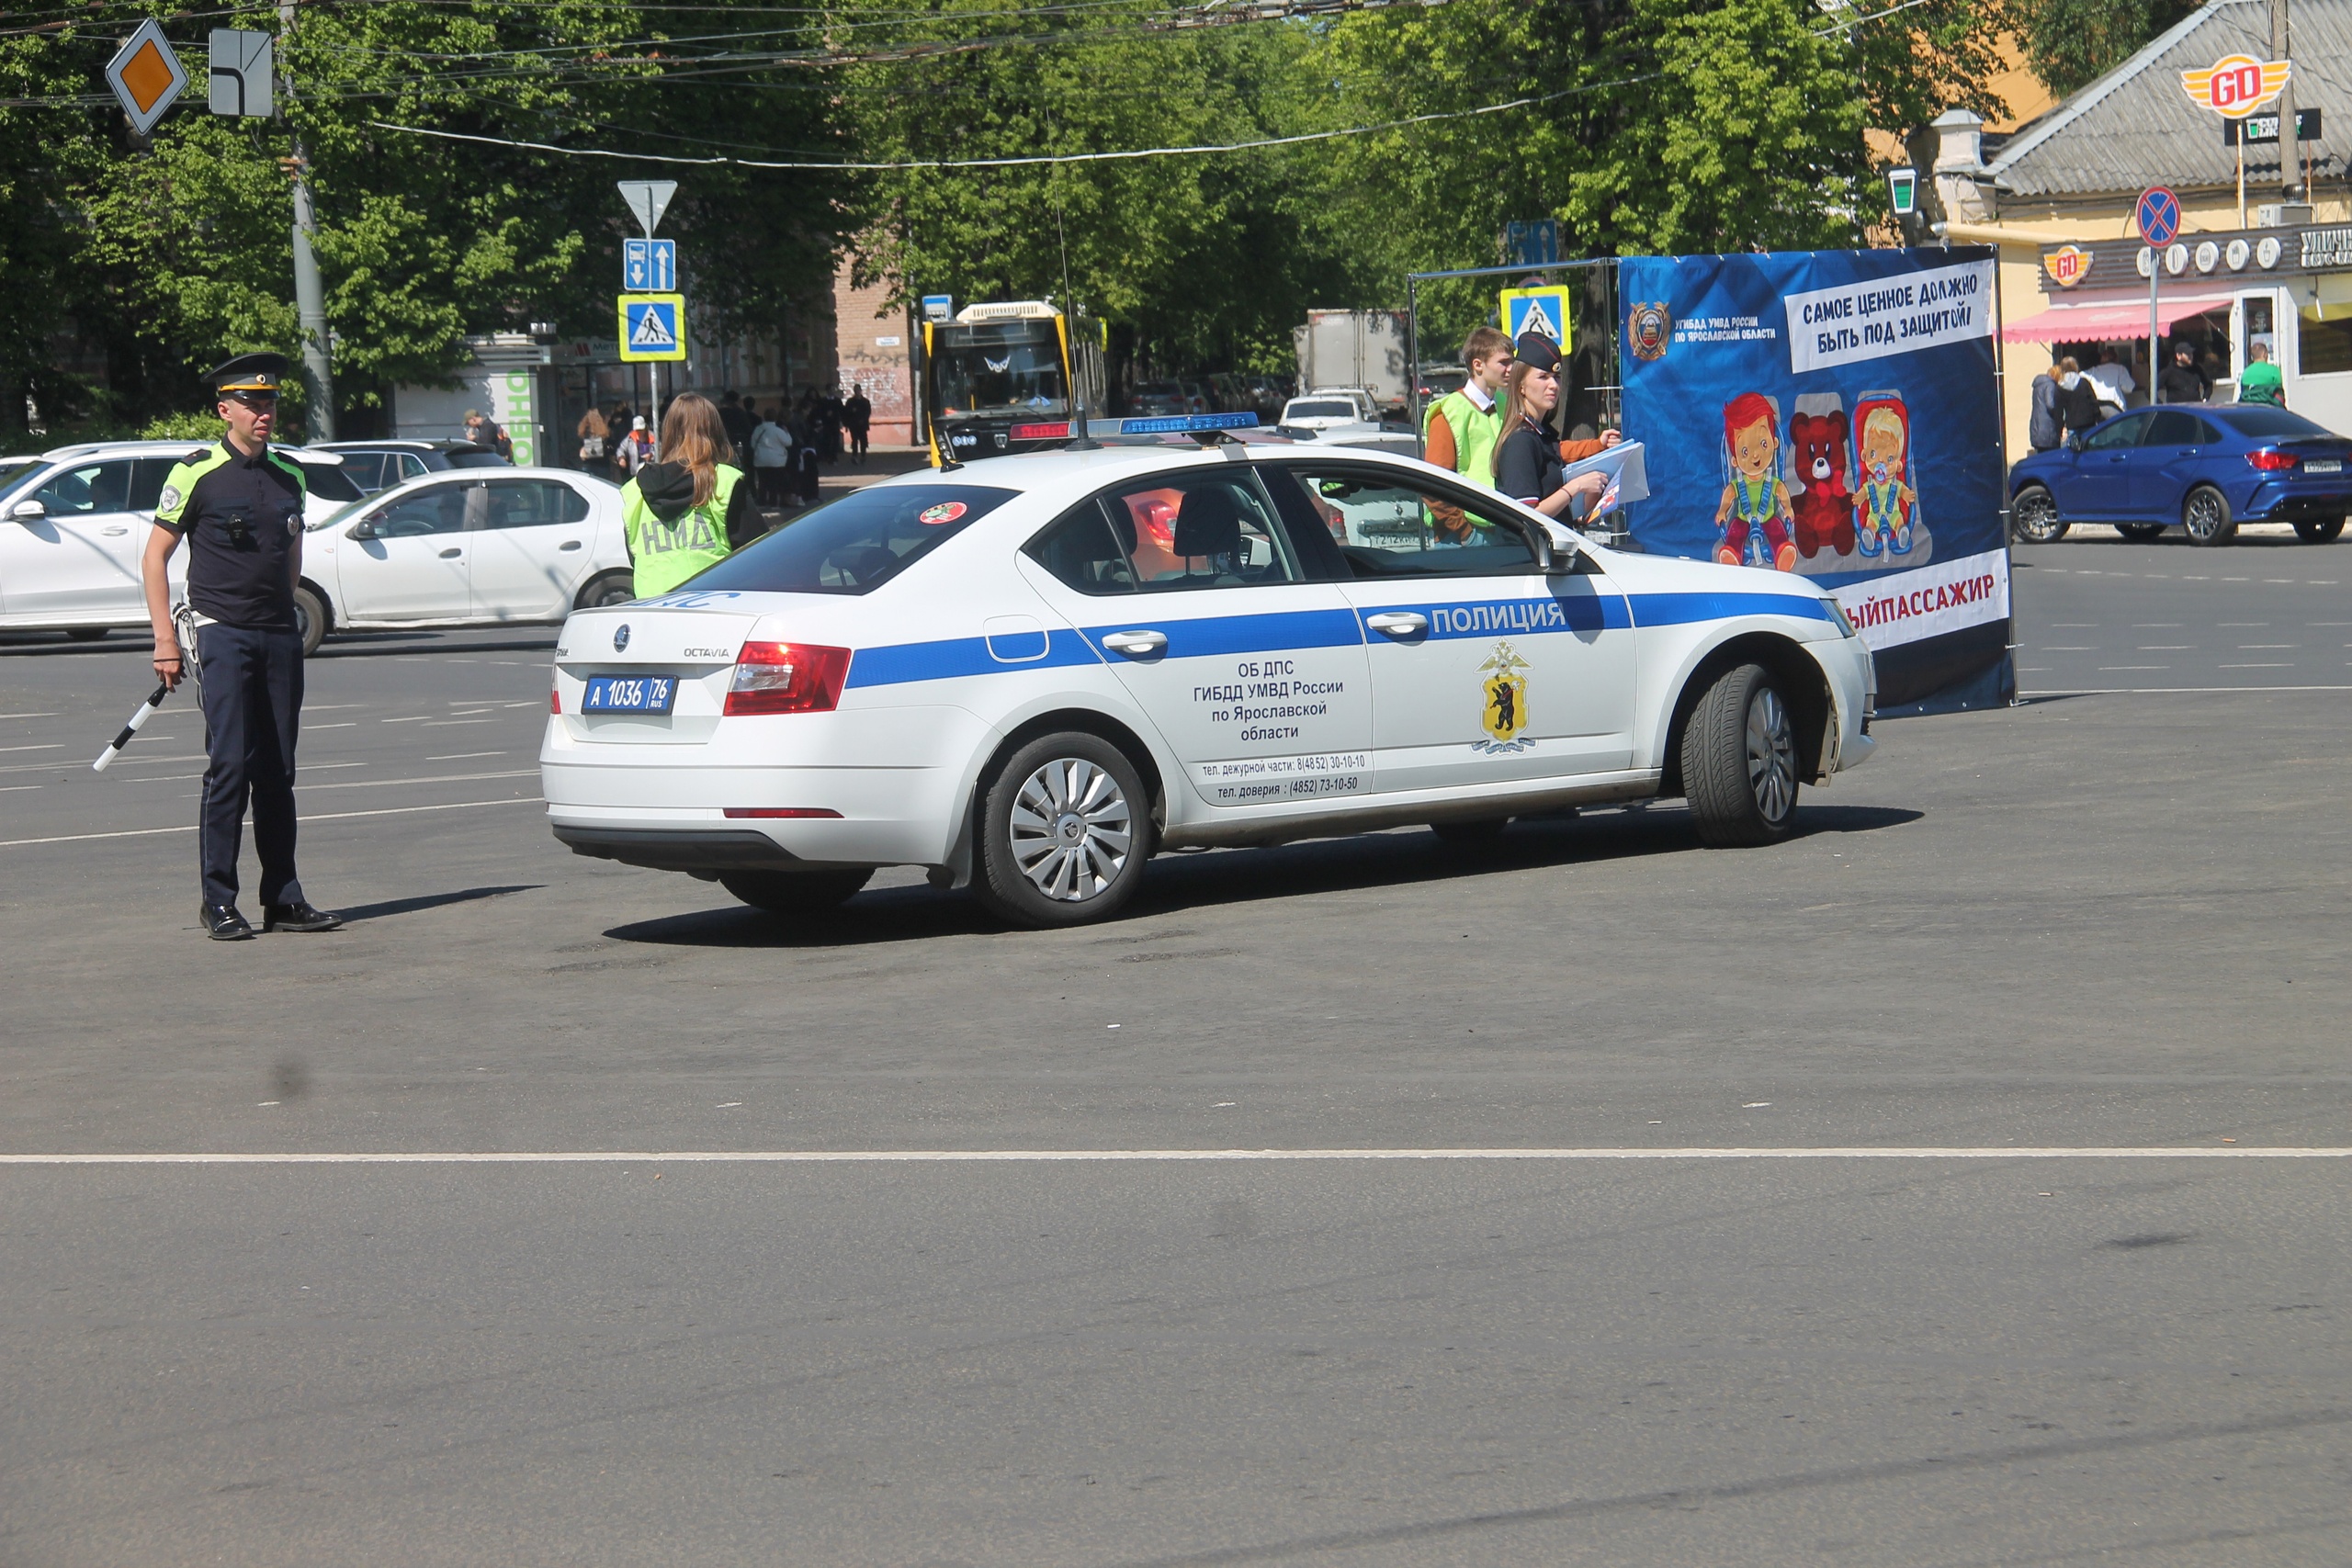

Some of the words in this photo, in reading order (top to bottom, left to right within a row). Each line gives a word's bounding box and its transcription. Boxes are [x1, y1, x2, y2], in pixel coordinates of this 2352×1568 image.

[2211, 65, 2261, 107] GD
[2056, 254, 2077, 278] GD
[1803, 293, 1853, 325] САМОЕ
[1857, 285, 1913, 317] ЦЕННОЕ
[1918, 273, 1978, 304] ДОЛЖНО
[1675, 318, 1707, 331] УГИБДД
[1708, 317, 1731, 330] УМВД
[1731, 316, 1758, 329] РОССИИ
[1816, 323, 1860, 354] БЫТЬ
[1864, 323, 1895, 346] ПОД
[1900, 303, 1973, 338] ЗАЩИТОЙ!
[1674, 332, 1686, 343] ПО
[1687, 327, 1741, 343] ЯРОСЛАВСКОЙ
[1741, 328, 1776, 340] ОБЛАСТИ
[1845, 575, 1995, 630] ЫЙПАССАЖИР
[1431, 602, 1566, 633] ПОЛИЦИЯ
[684, 648, 729, 658] OCTAVIA
[1238, 662, 1259, 678] ОБ
[1263, 660, 1294, 679] ДПС
[607, 680, 644, 706] 1036
[651, 680, 668, 700] 76
[1193, 684, 1243, 703] ГИБДД
[1248, 682, 1288, 699] УМВД
[1293, 681, 1343, 695] России
[650, 700, 663, 708] RUS
[1212, 710, 1229, 722] по
[1234, 701, 1327, 723] Ярославской
[1241, 726, 1299, 740] области
[1203, 765, 1220, 776] тел.
[1223, 760, 1266, 777] дежурной
[1268, 761, 1295, 773] части:
[1330, 755, 1365, 769] 30-10-10
[1217, 787, 1237, 798] тел.
[1238, 784, 1280, 799] доверия
[1289, 780, 1317, 796] (4852)
[1320, 776, 1358, 791] 73-10-50
